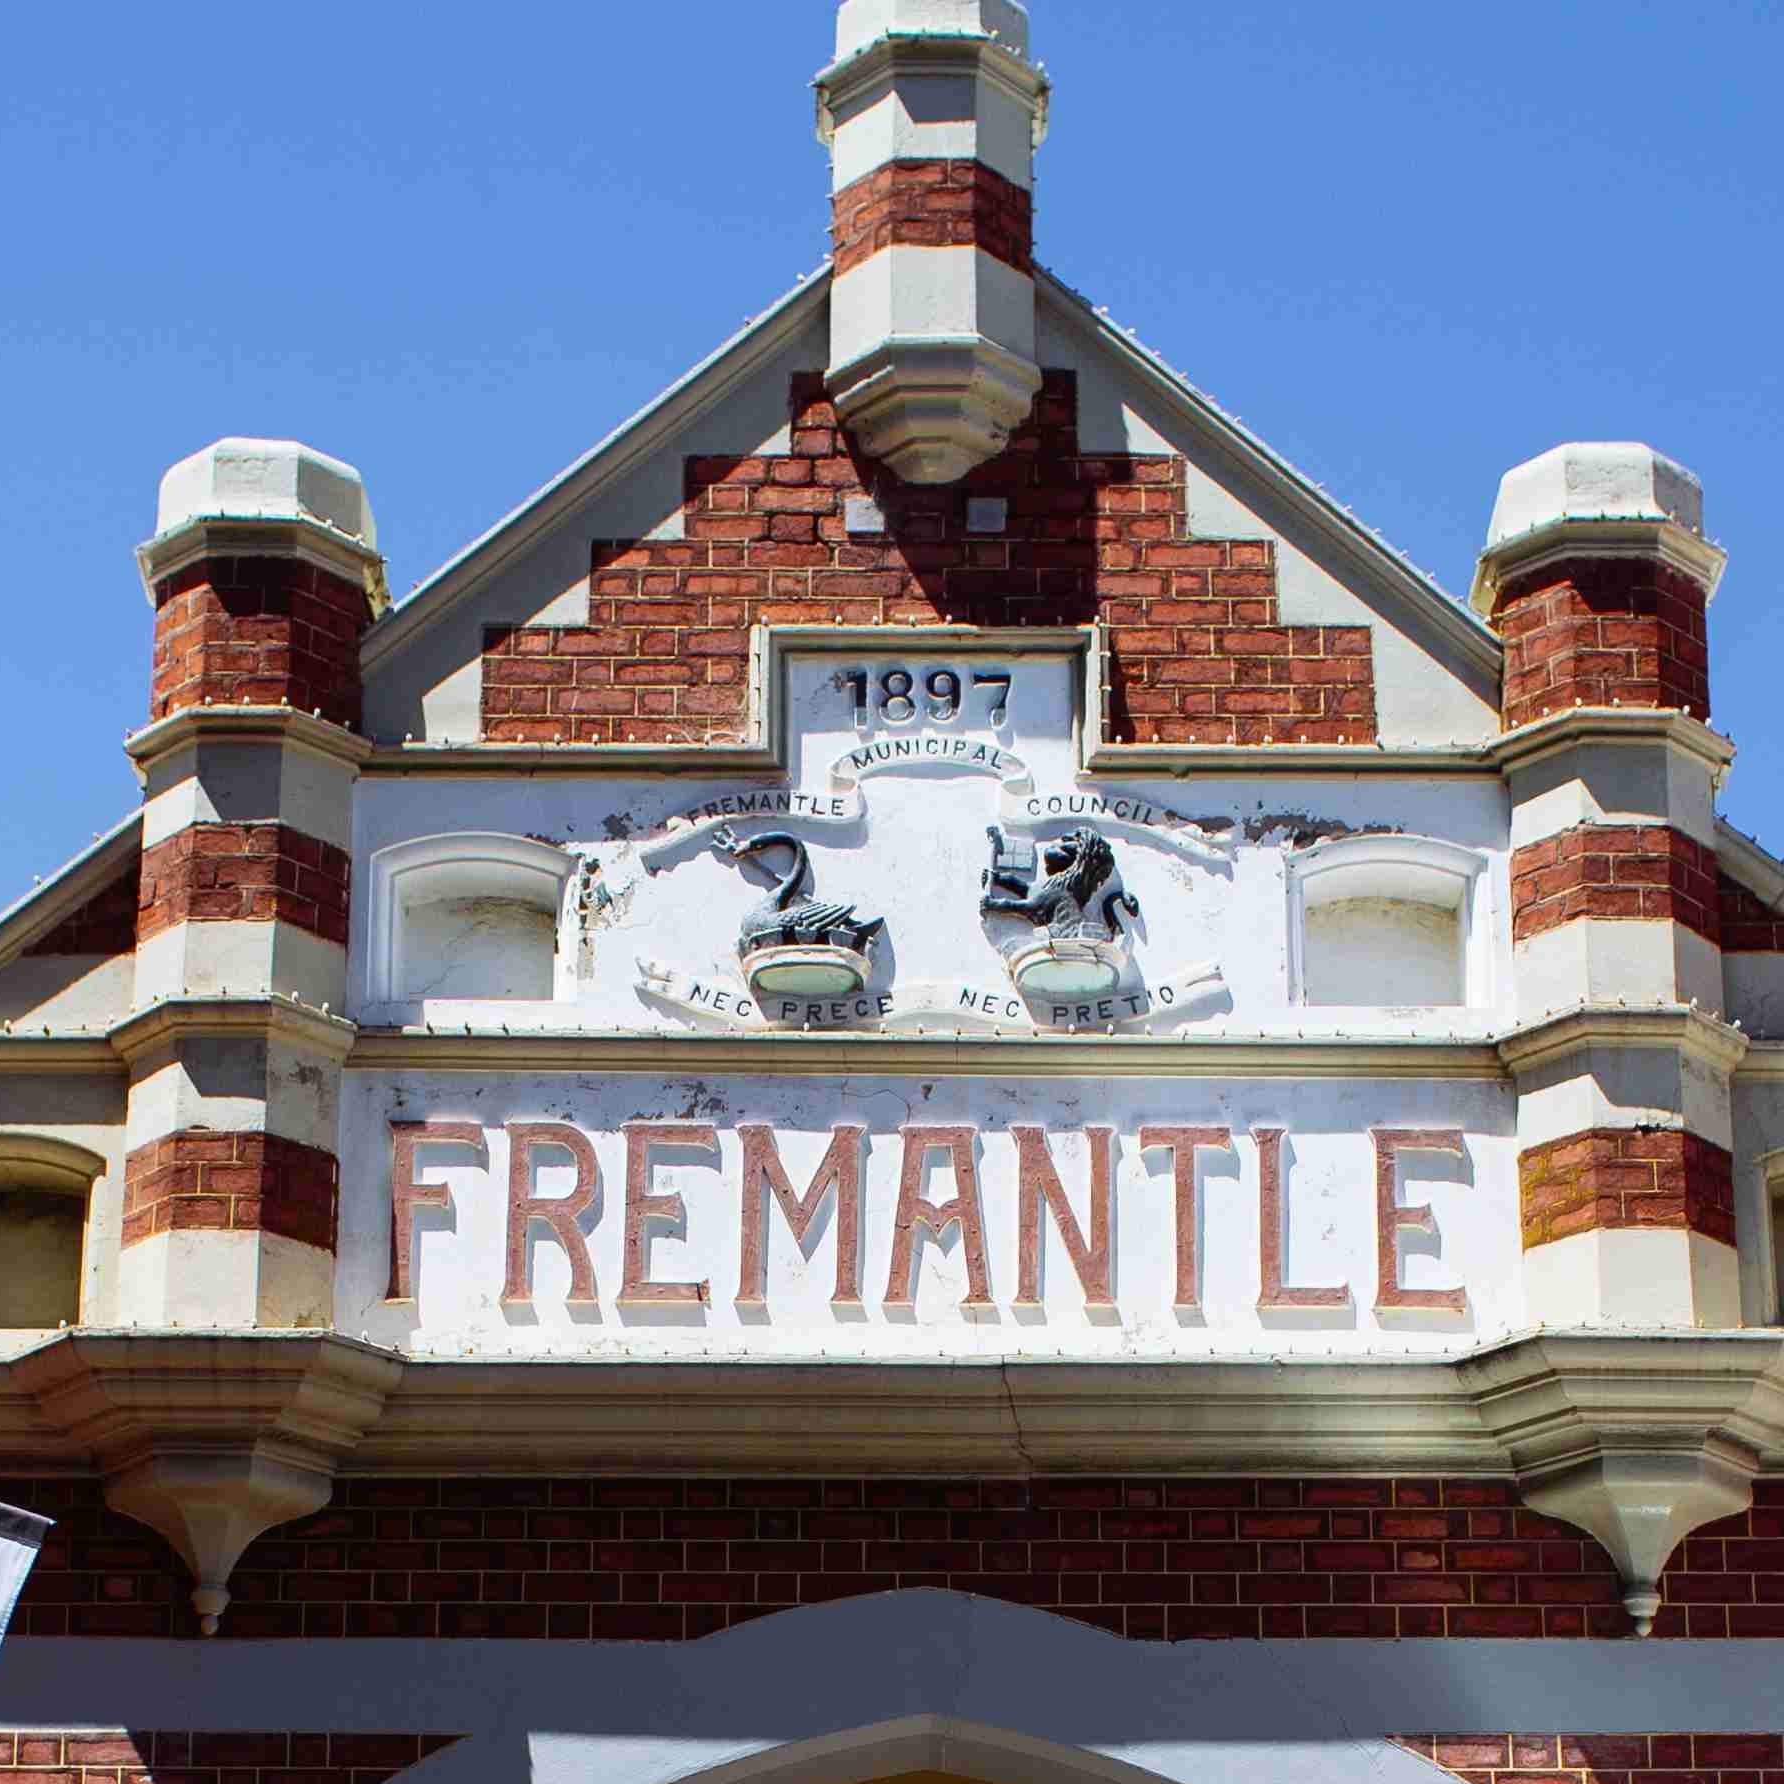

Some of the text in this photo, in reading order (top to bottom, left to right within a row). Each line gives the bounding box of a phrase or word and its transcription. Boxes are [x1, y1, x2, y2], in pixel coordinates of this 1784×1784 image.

[845, 670, 1014, 730] 1897
[686, 738, 1158, 827] FREMANTLE MUNICIPAL COUNCIL
[689, 985, 1175, 1024] NEC PRECE NEC PRETIO
[385, 1121, 1468, 1309] FREMANTLE
